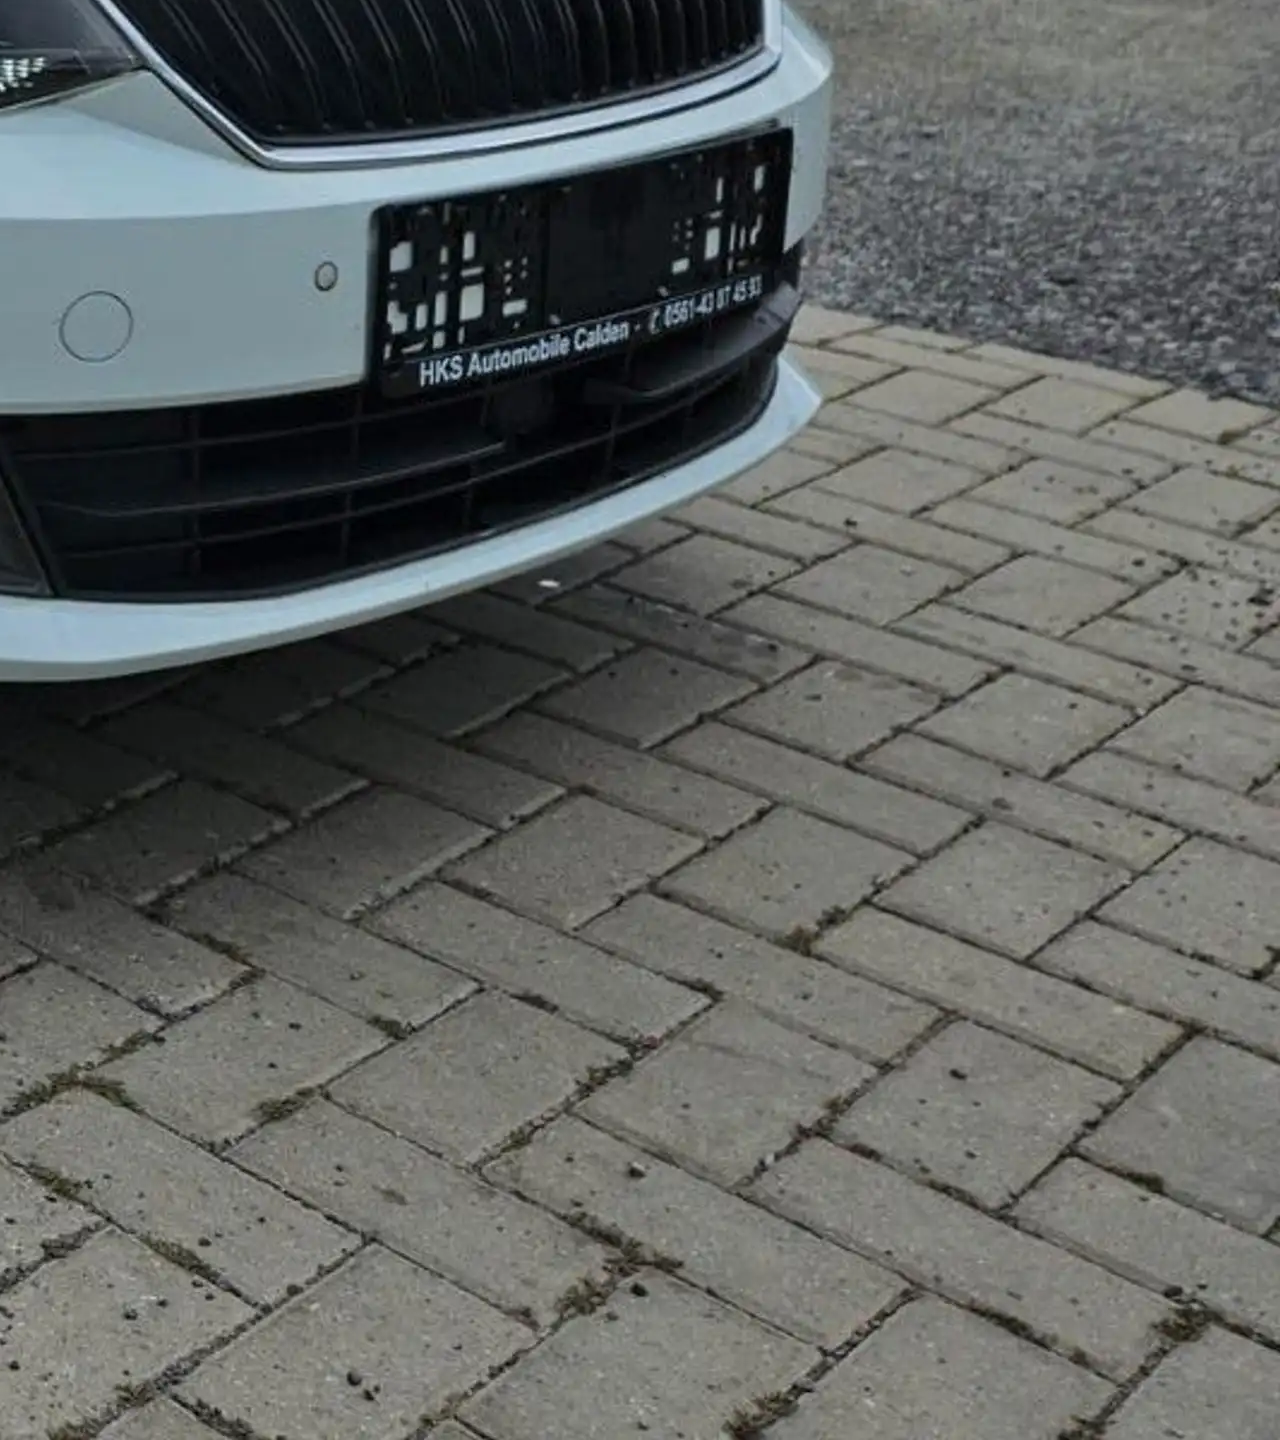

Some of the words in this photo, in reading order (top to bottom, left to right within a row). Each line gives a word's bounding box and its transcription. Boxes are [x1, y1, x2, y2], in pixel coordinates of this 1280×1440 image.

[420, 355, 463, 388] HKS
[466, 333, 570, 377] Automobile
[574, 321, 630, 351] Calden
